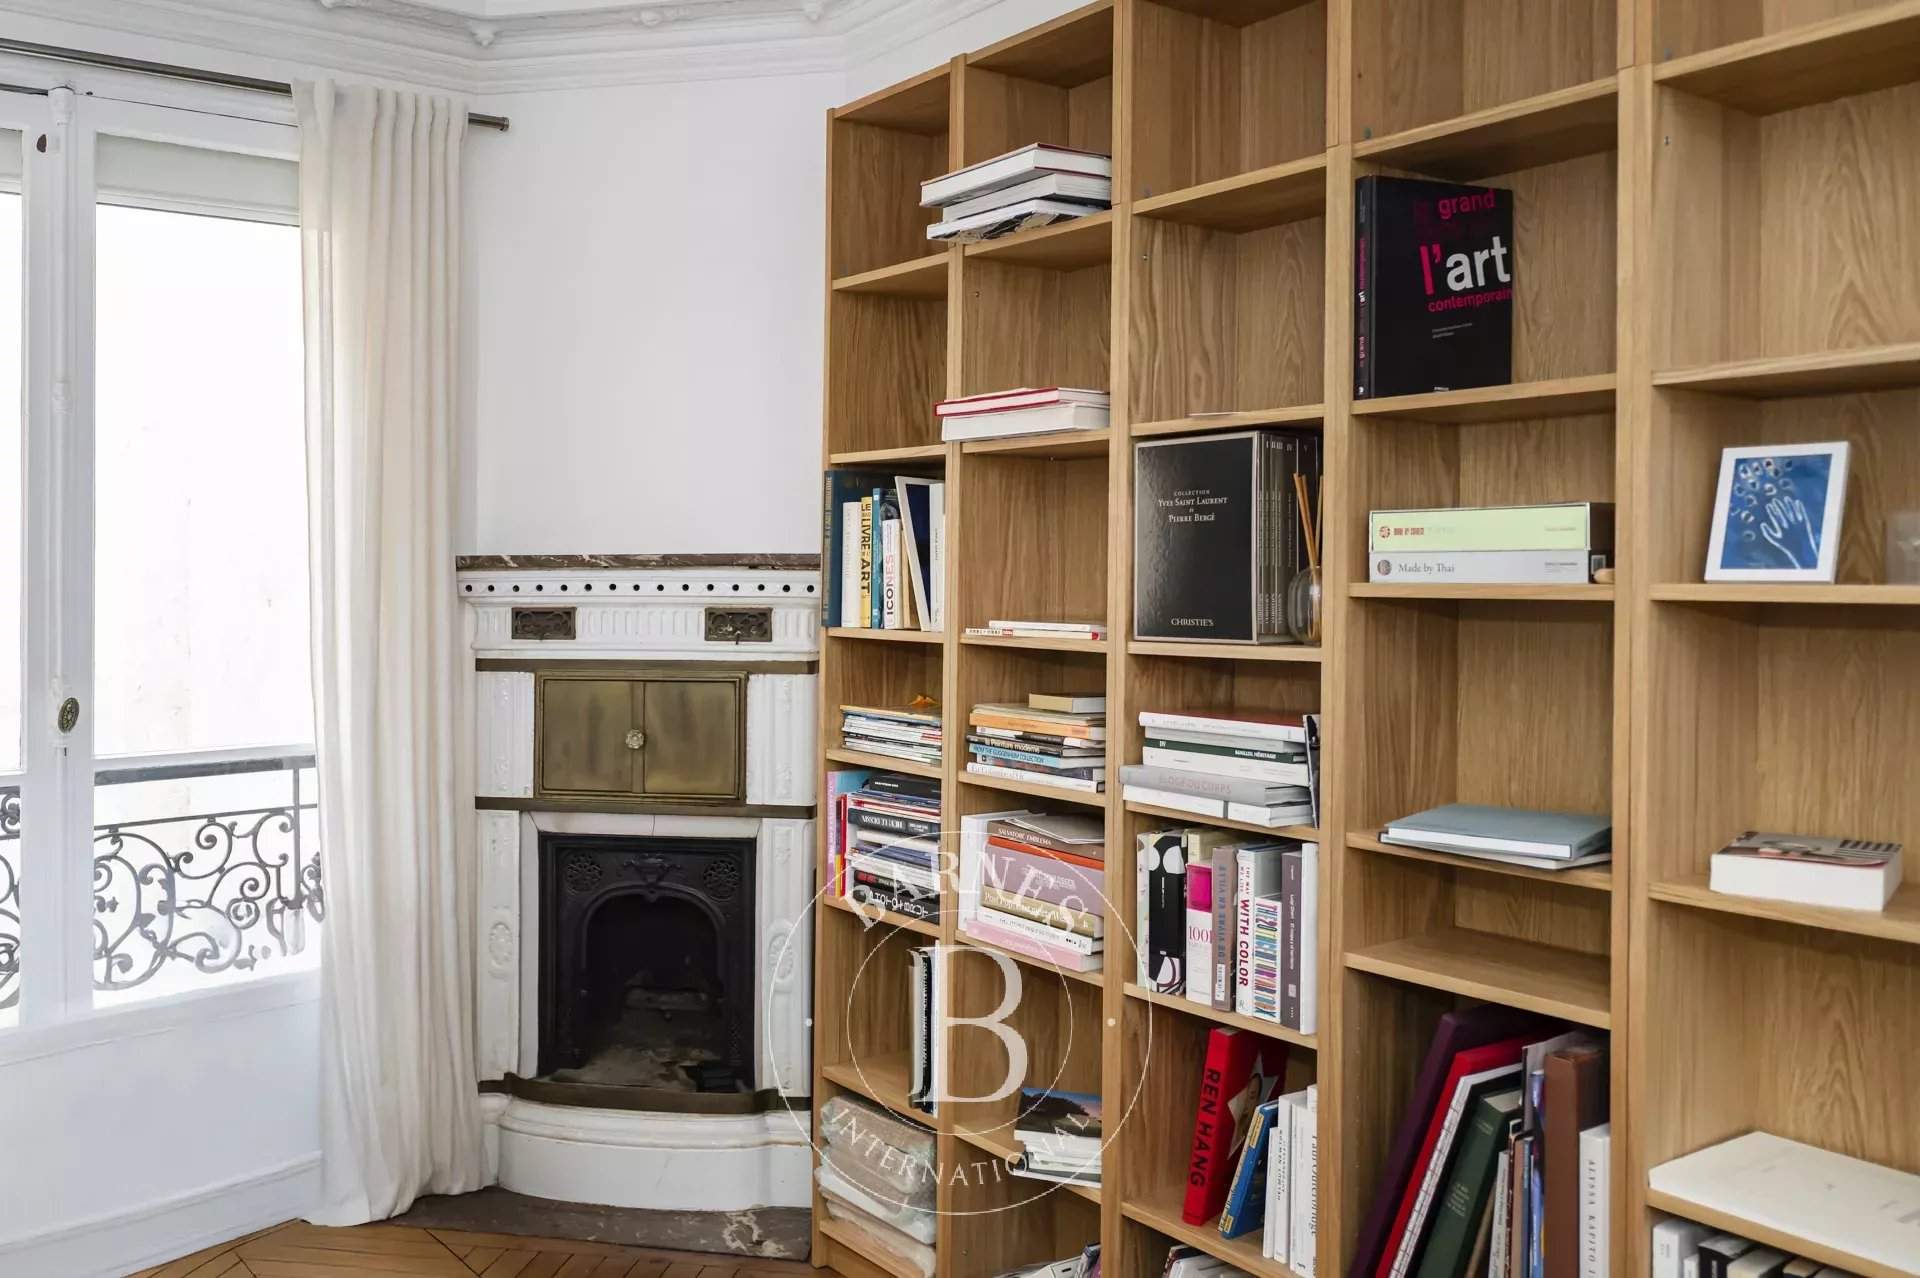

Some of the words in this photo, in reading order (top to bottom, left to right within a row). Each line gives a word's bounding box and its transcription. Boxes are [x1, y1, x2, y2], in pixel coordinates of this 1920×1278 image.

[1438, 188, 1496, 220] grand
[1420, 236, 1512, 296] l'art
[861, 518, 871, 550] LIVRE
[886, 554, 894, 615] ICONES
[1239, 899, 1250, 936] WITH
[1239, 940, 1249, 987] COLOR
[1200, 1068, 1222, 1116] REN
[1190, 1121, 1217, 1188] HANG
